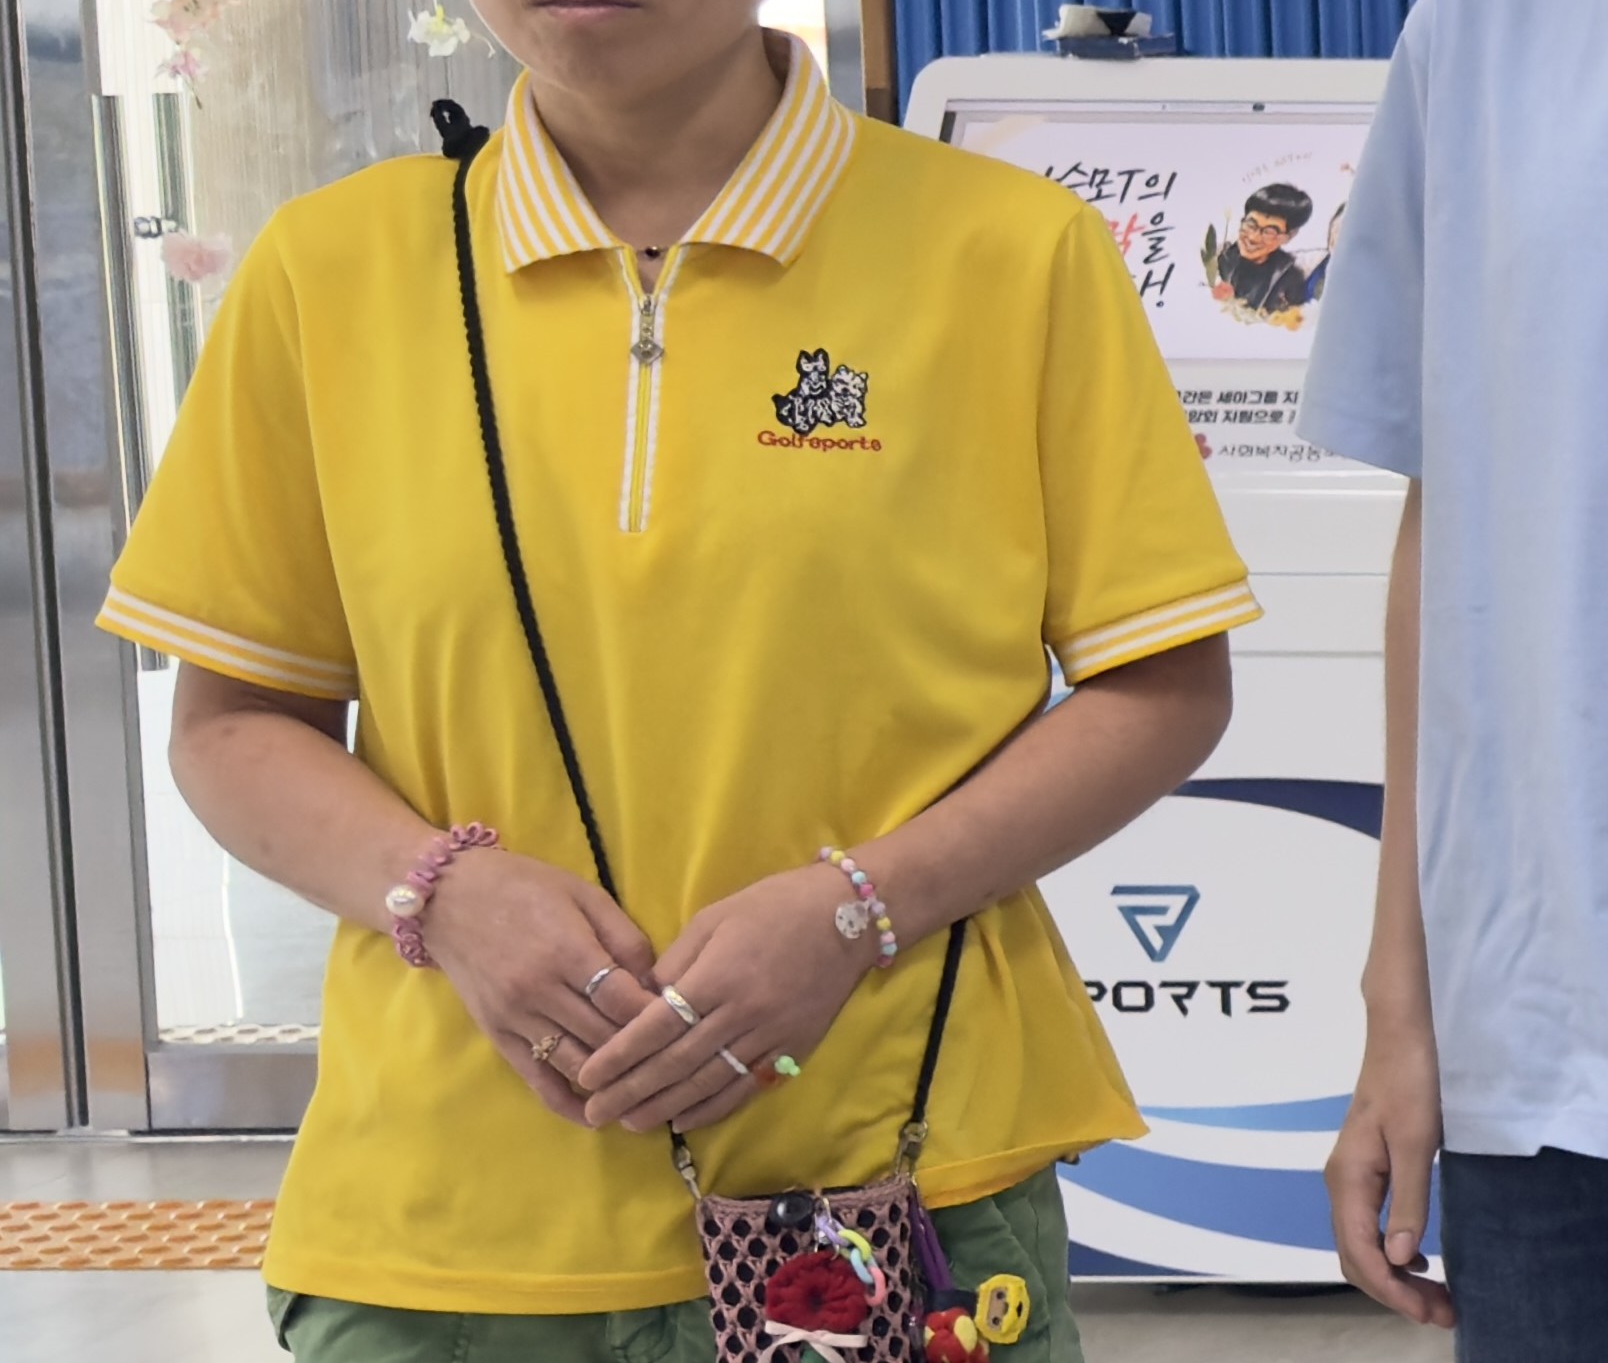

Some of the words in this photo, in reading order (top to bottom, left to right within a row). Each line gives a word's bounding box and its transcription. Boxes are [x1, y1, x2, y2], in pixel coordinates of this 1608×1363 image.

[1045, 161, 1178, 204] 수모T의
[1178, 390, 1213, 405] 간은
[1084, 980, 1291, 1017] PORTS
